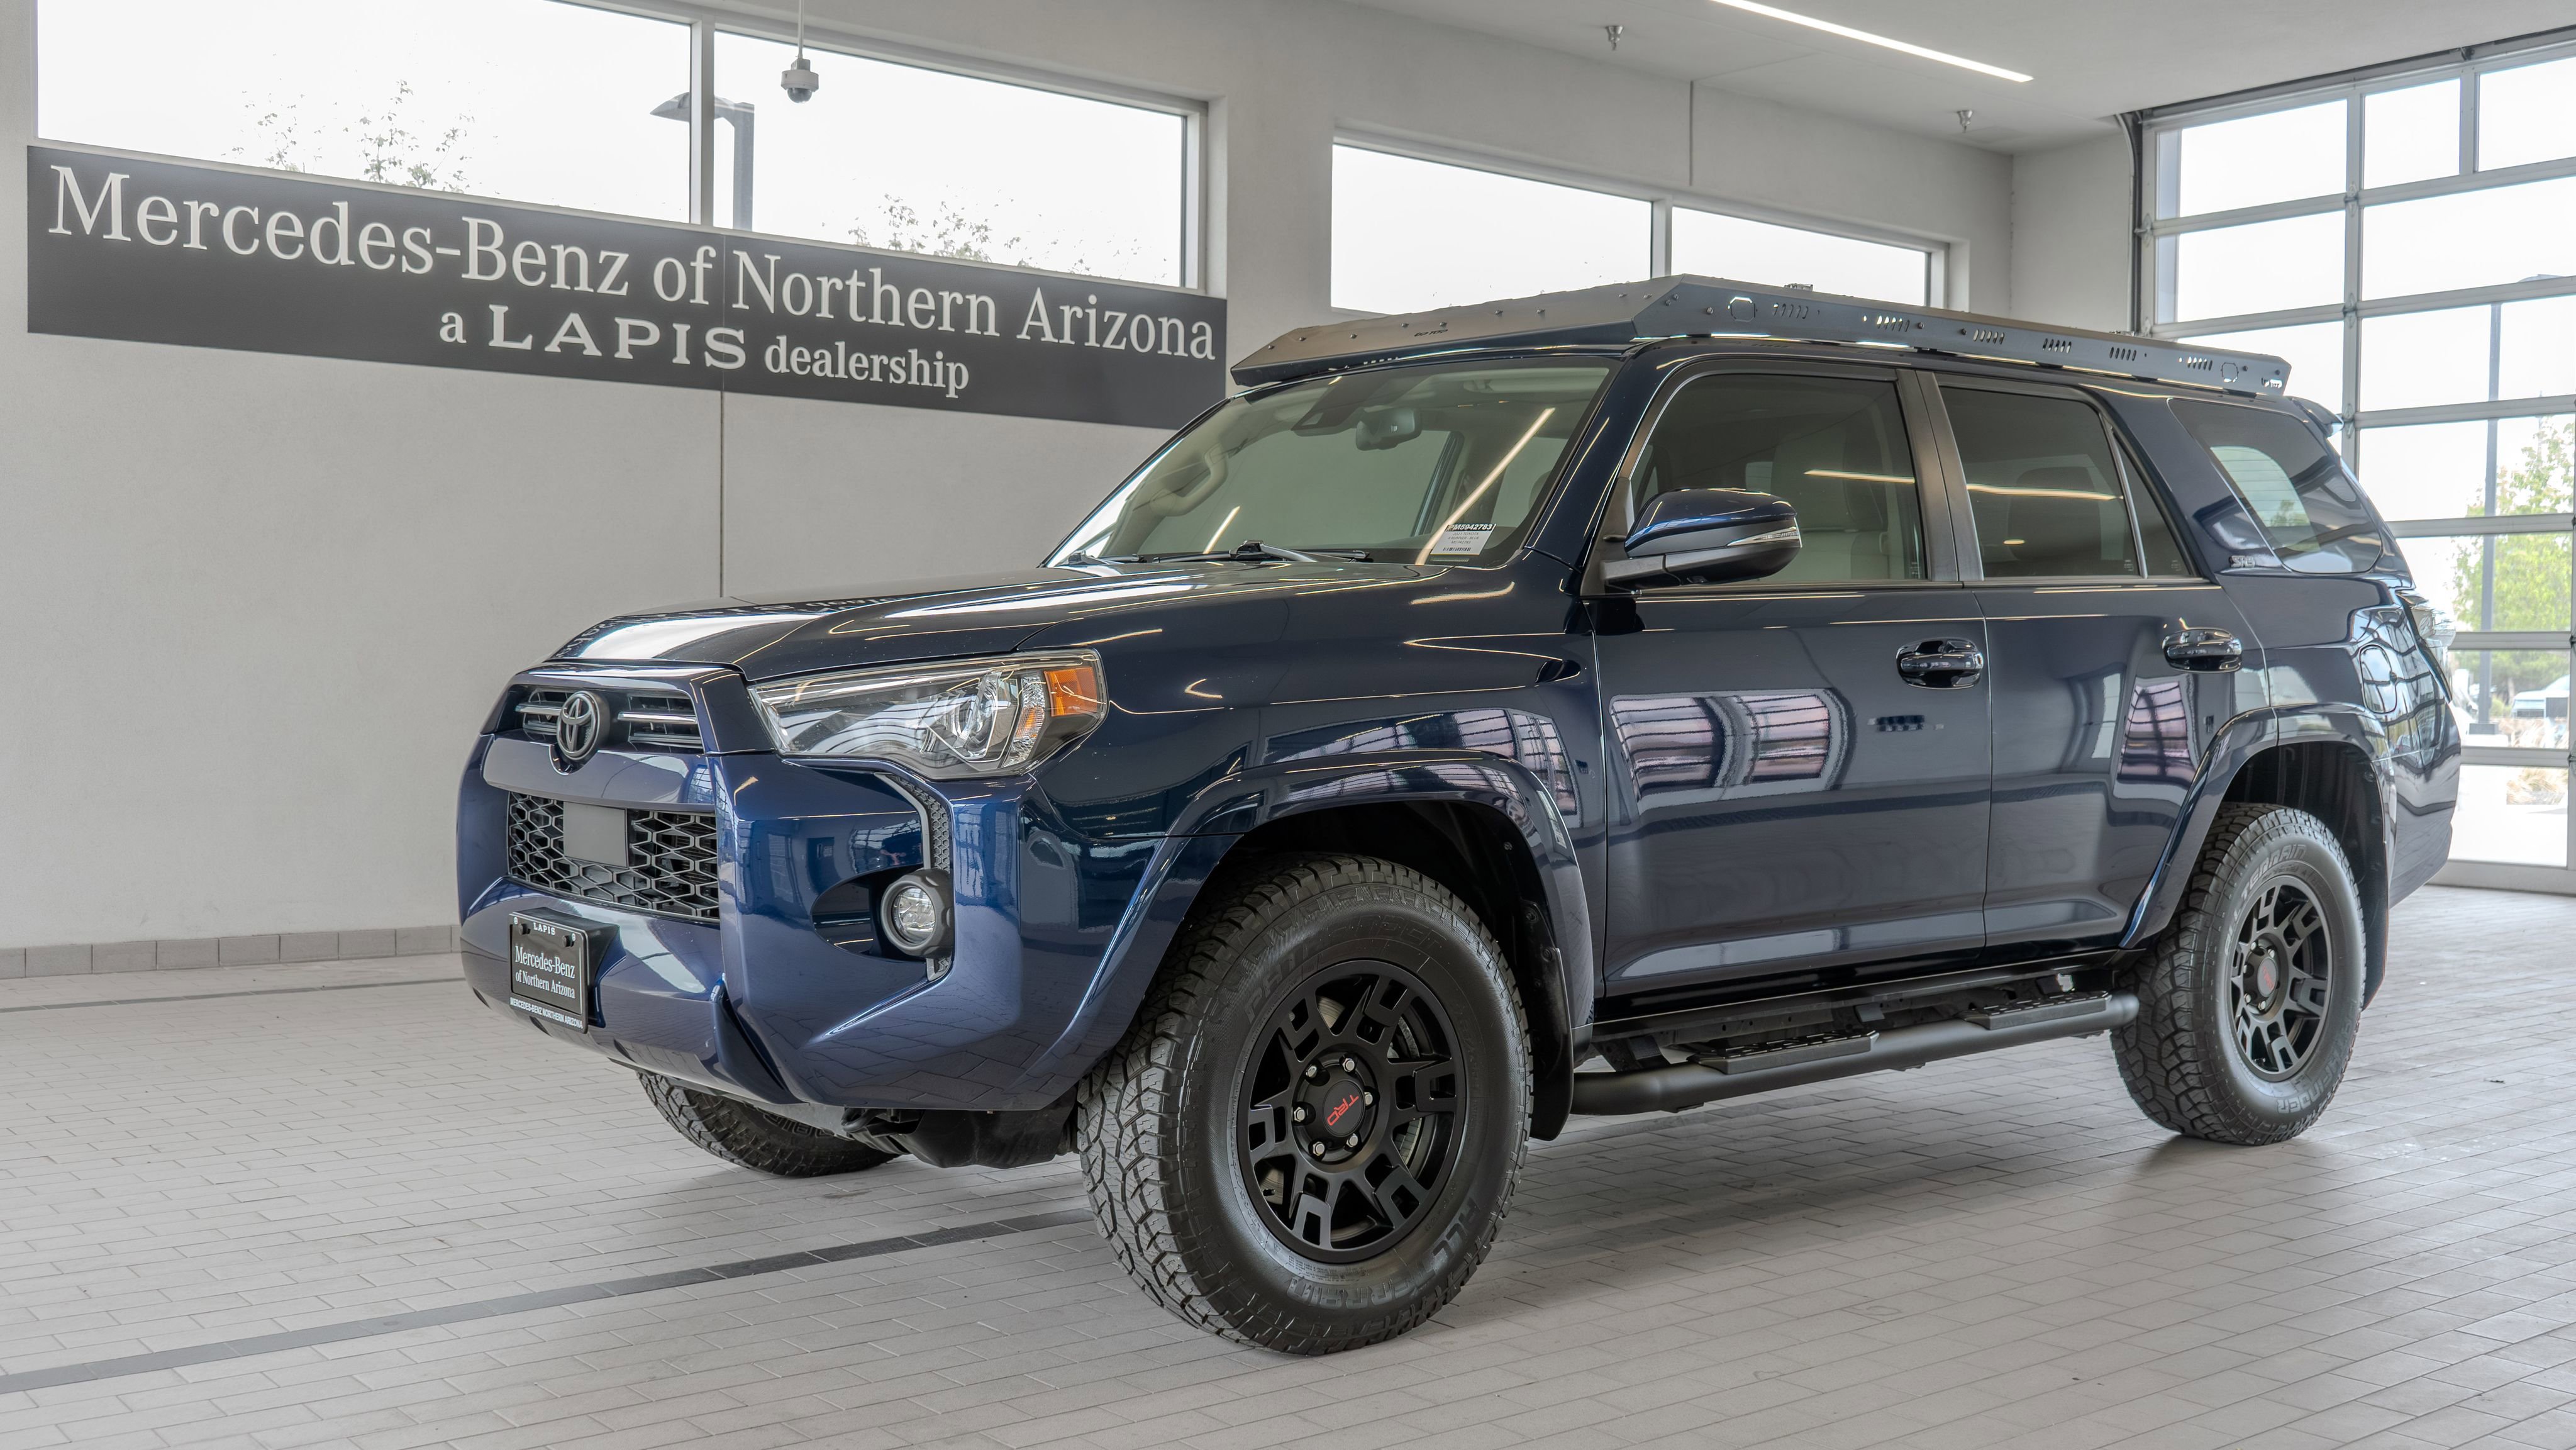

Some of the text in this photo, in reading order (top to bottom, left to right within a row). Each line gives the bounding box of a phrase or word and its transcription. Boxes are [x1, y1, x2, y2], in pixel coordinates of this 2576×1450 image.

[48, 165, 1216, 360] Mercedes-Benz of Northern Arizona
[439, 304, 969, 399] a LAPIS dealership
[2228, 555, 2255, 567] SR5
[533, 922, 556, 935] LAPIS
[514, 945, 575, 979] Mercedes-Benz
[515, 969, 575, 999] of Northern Arizona
[510, 997, 583, 1029] MERCEDES-BENZ NORTHERN ARIZONA
[1327, 1095, 1359, 1126] TRD
